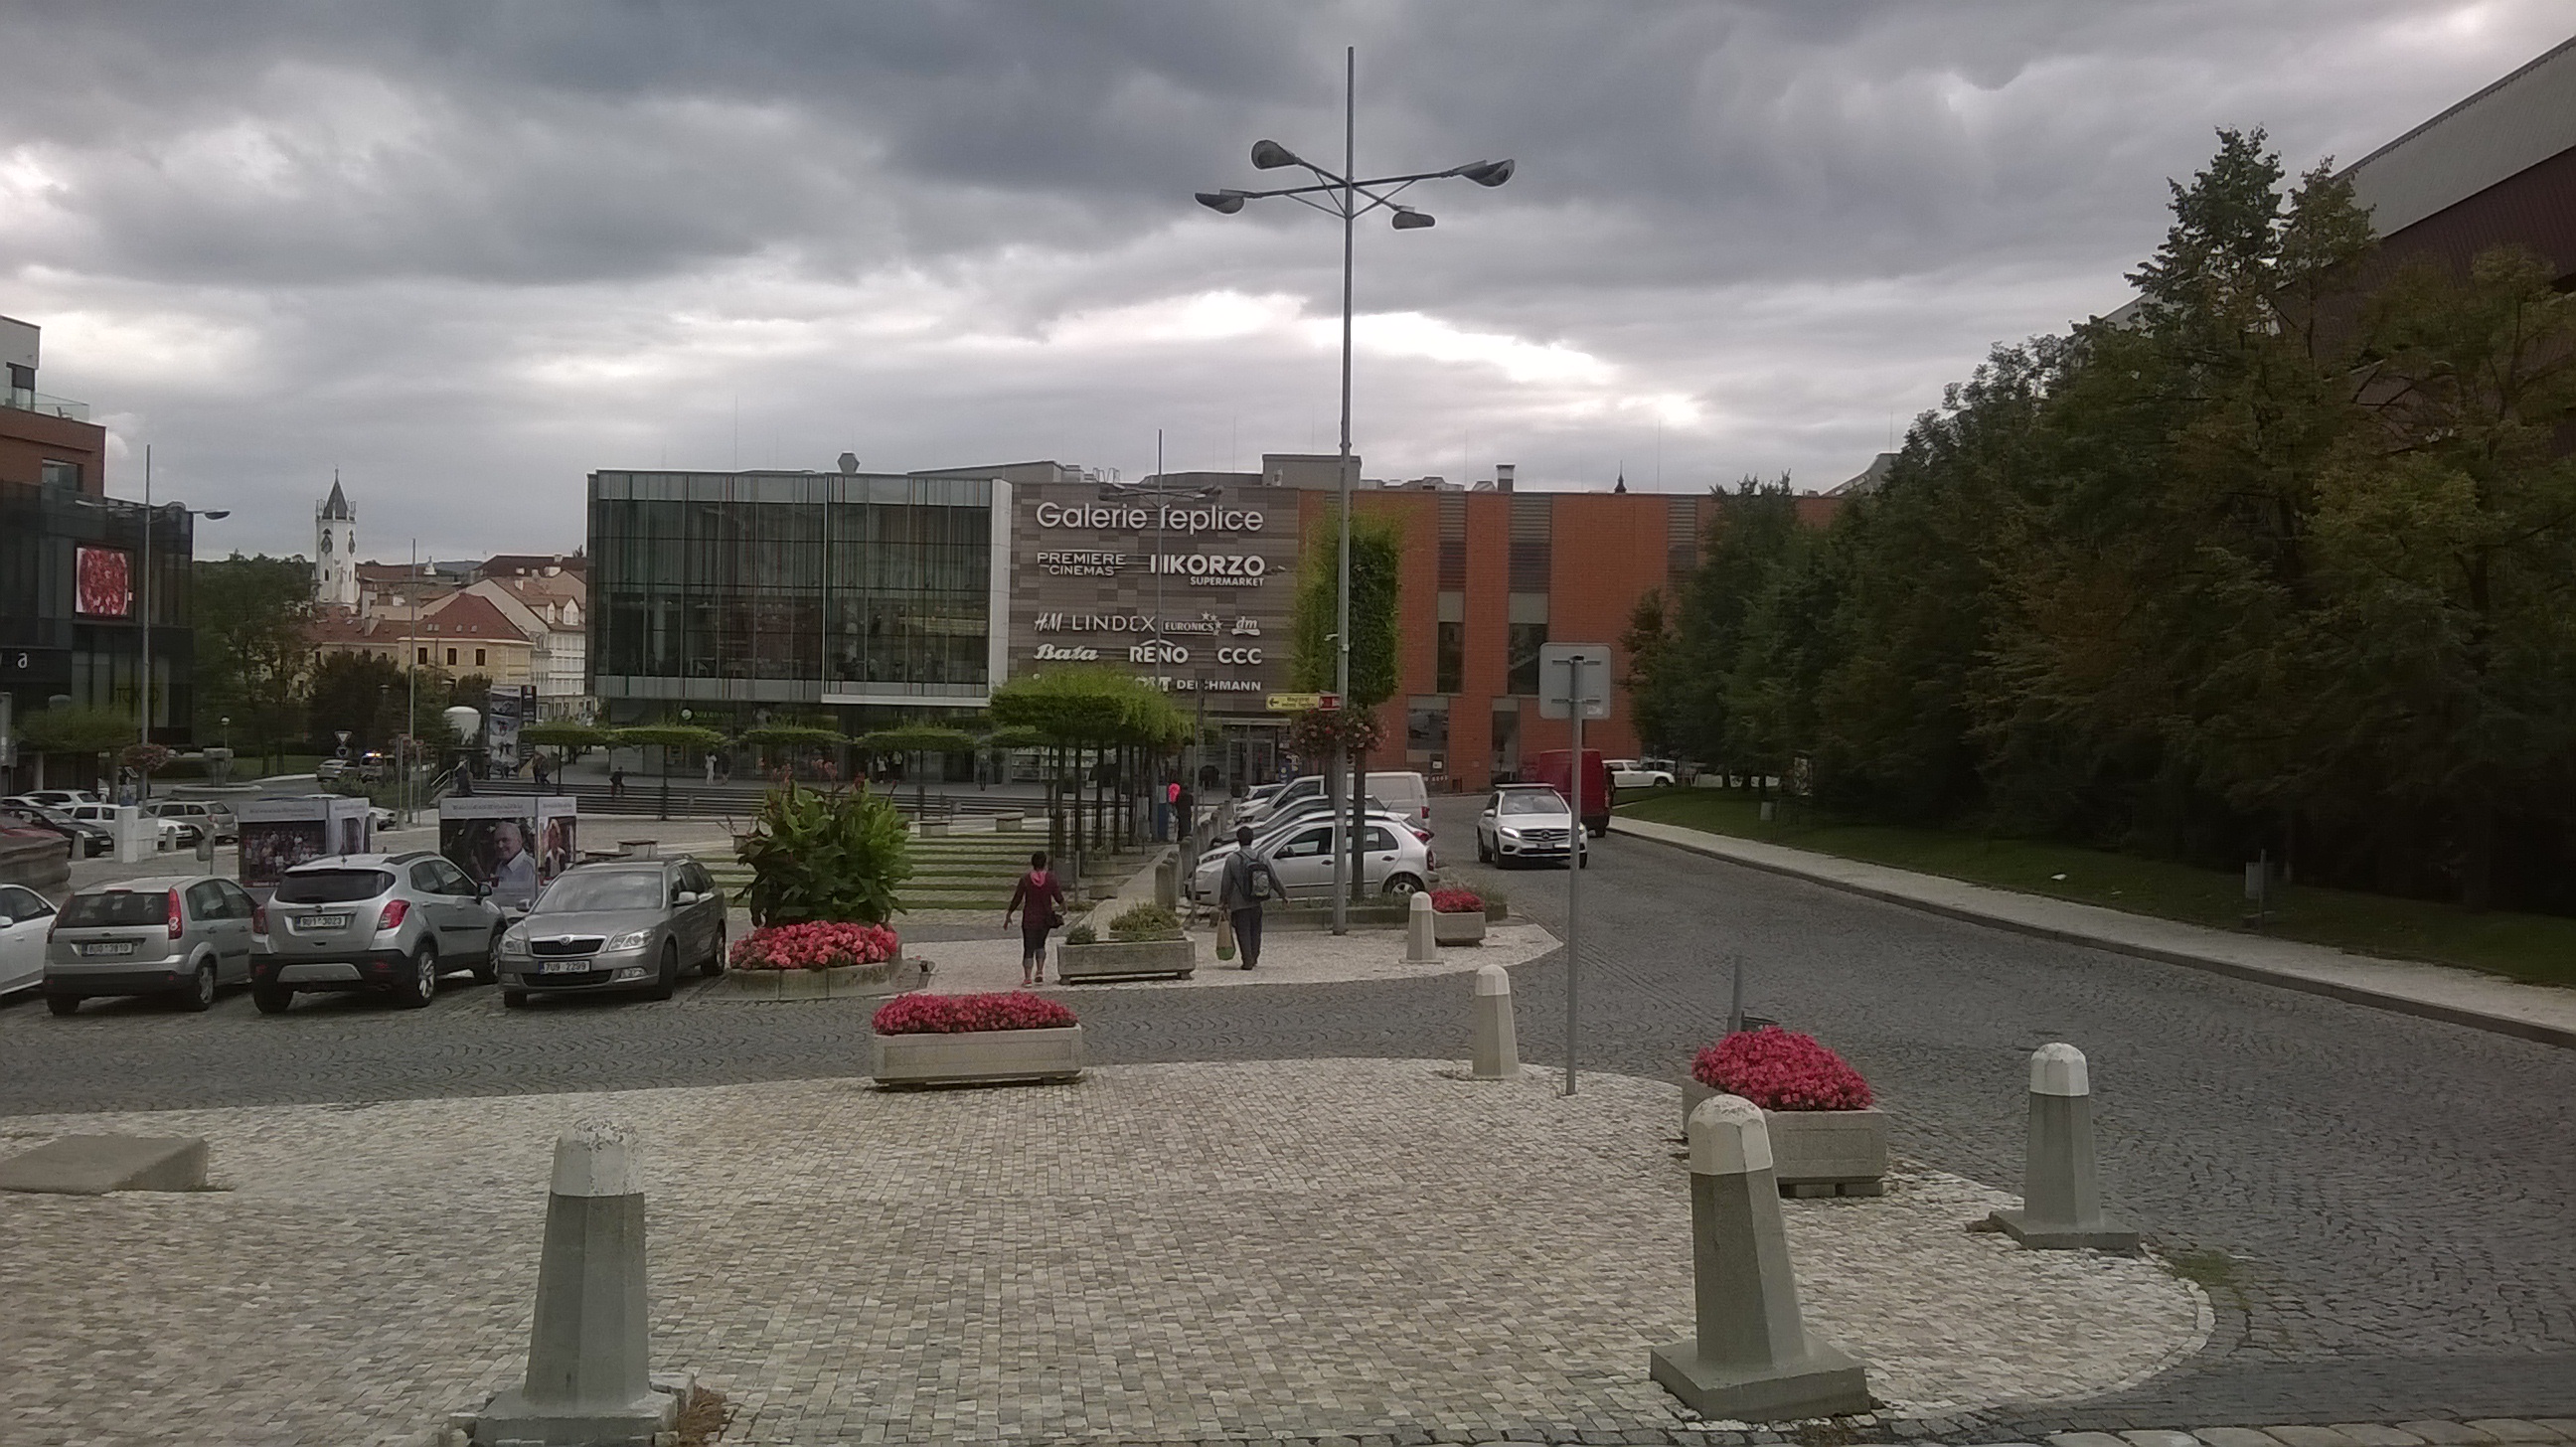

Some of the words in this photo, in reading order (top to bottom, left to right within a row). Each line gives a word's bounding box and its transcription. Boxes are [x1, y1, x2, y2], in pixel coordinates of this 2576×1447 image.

[1036, 501, 1147, 529] Galerie
[1037, 552, 1127, 565] PREMIERE
[1048, 564, 1115, 576] CINEMAS
[1190, 576, 1264, 586] SUPERMARKET
[1071, 614, 1156, 632] LINDEX
[1164, 621, 1214, 632] EURONICS
[1235, 615, 1258, 629] dm
[1129, 646, 1189, 663] RENO
[1217, 647, 1262, 664] CCC
